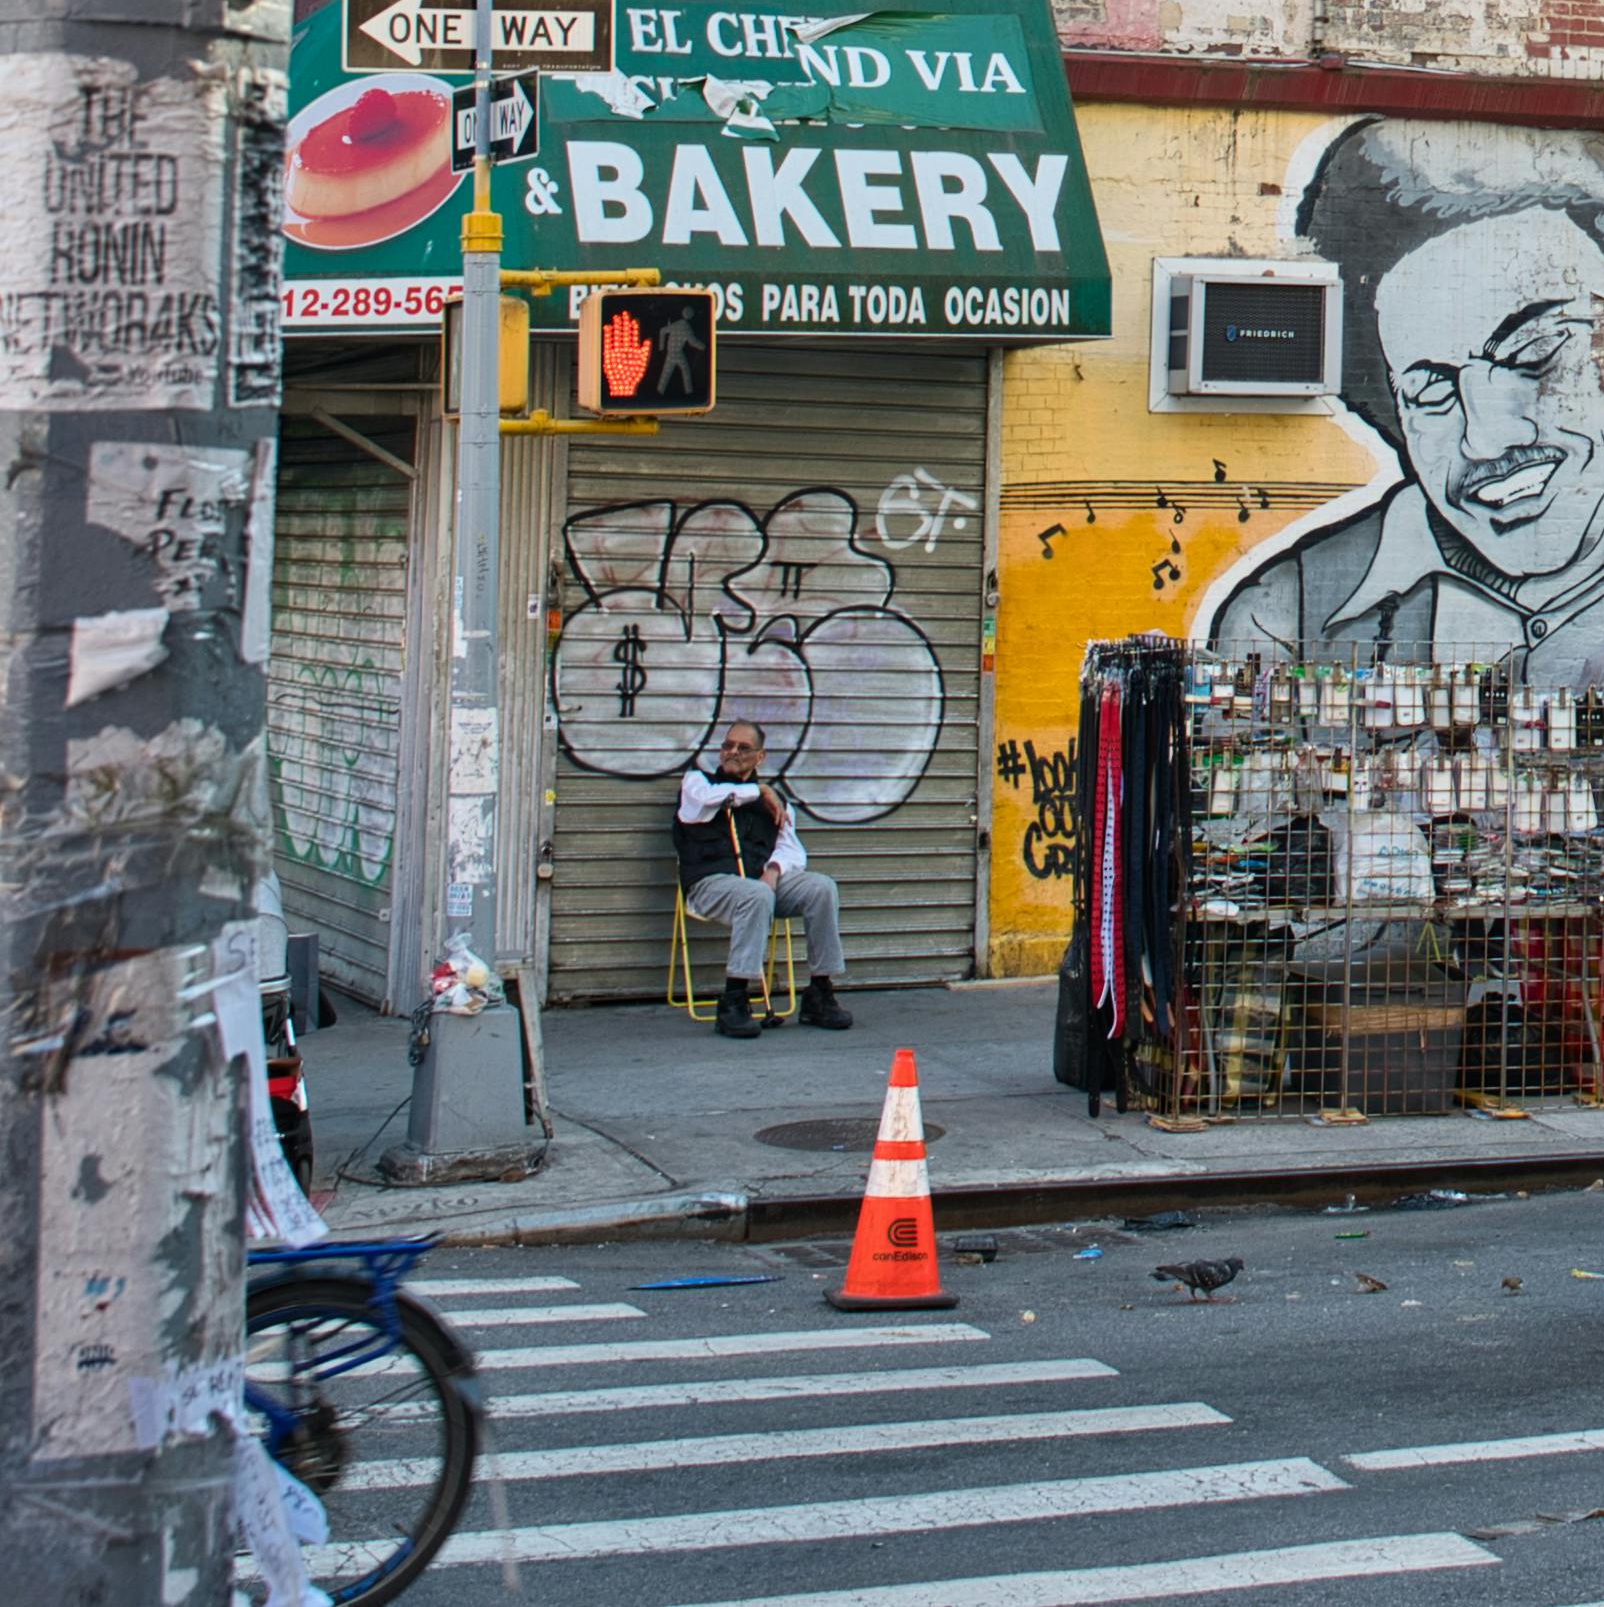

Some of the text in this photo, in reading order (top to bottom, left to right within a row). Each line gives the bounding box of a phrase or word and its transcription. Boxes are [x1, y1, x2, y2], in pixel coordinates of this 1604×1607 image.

[389, 12, 578, 46] ONE WAY
[626, 7, 692, 55] EL
[905, 49, 1027, 94] VIA
[500, 100, 525, 136] WAY
[44, 151, 179, 215] UNITED
[525, 139, 1069, 252] & BAKERY
[50, 221, 166, 285] RONIN
[762, 284, 840, 322] PARA
[849, 285, 927, 324] TODA
[944, 287, 1070, 326] OCASION
[1240, 329, 1295, 339] FRIEDRICH
